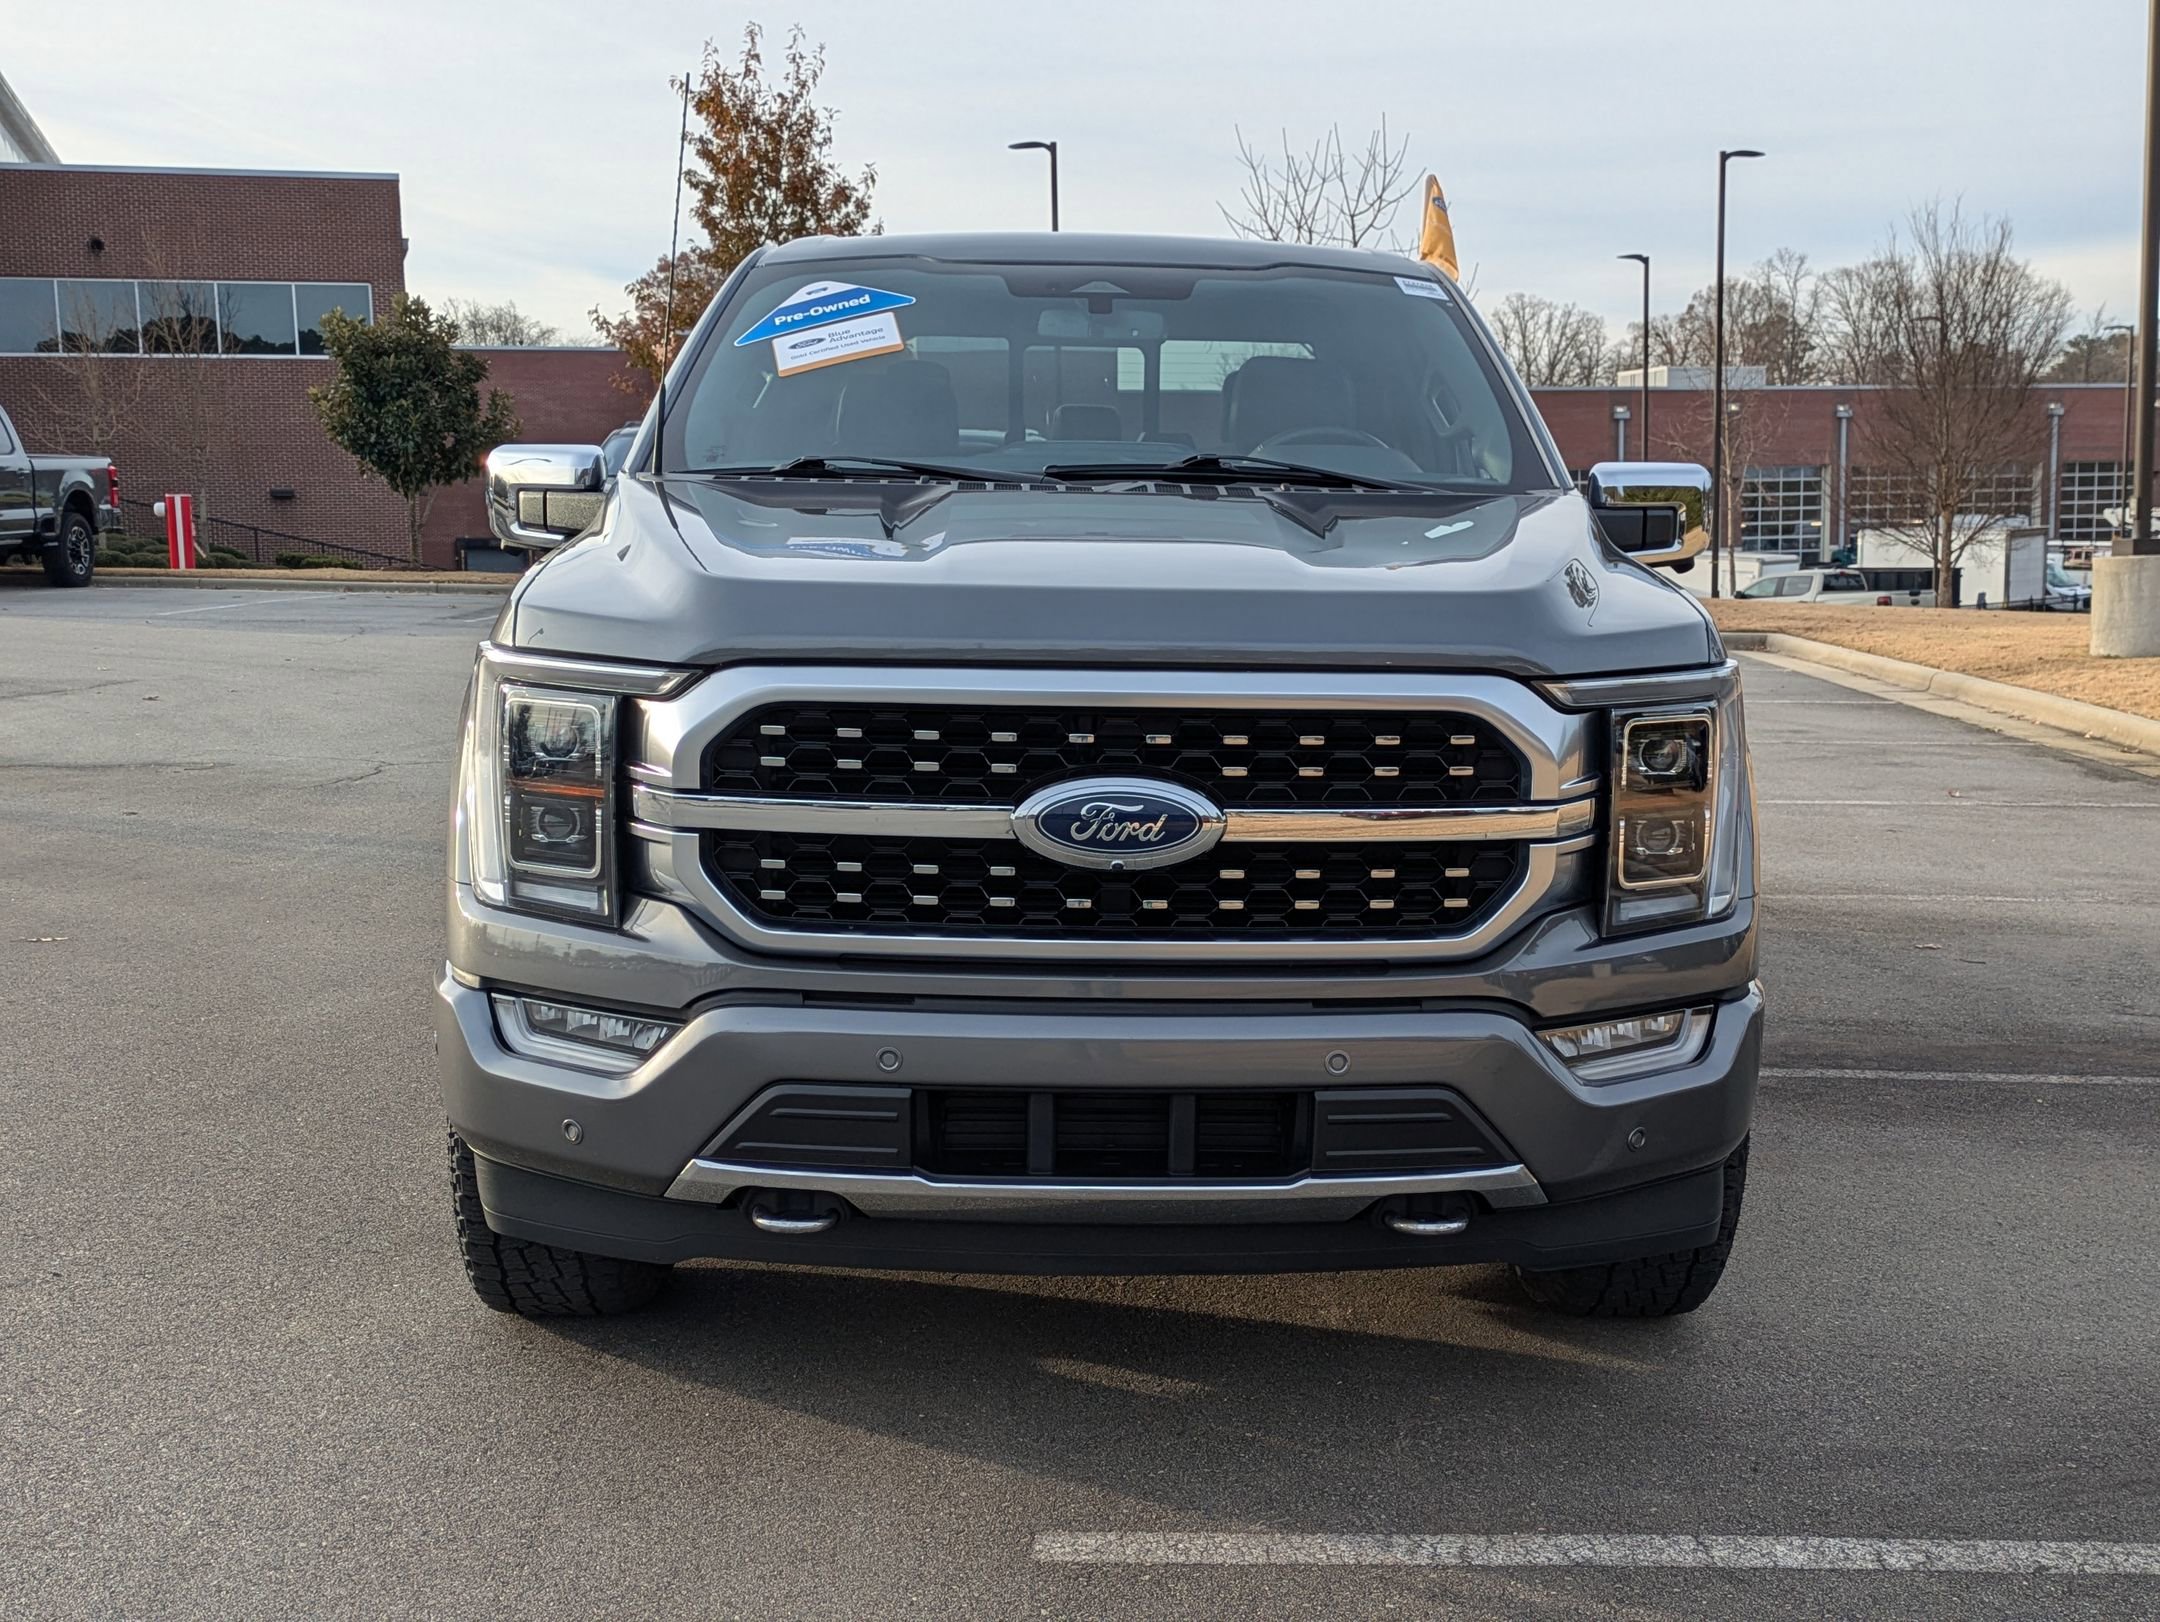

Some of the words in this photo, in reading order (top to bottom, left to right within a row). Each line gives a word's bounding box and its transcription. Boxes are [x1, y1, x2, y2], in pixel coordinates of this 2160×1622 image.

[774, 294, 871, 327] Pre-Owned
[828, 329, 851, 338] Blue
[829, 327, 884, 343] Advantage
[1070, 802, 1168, 842] Ford
